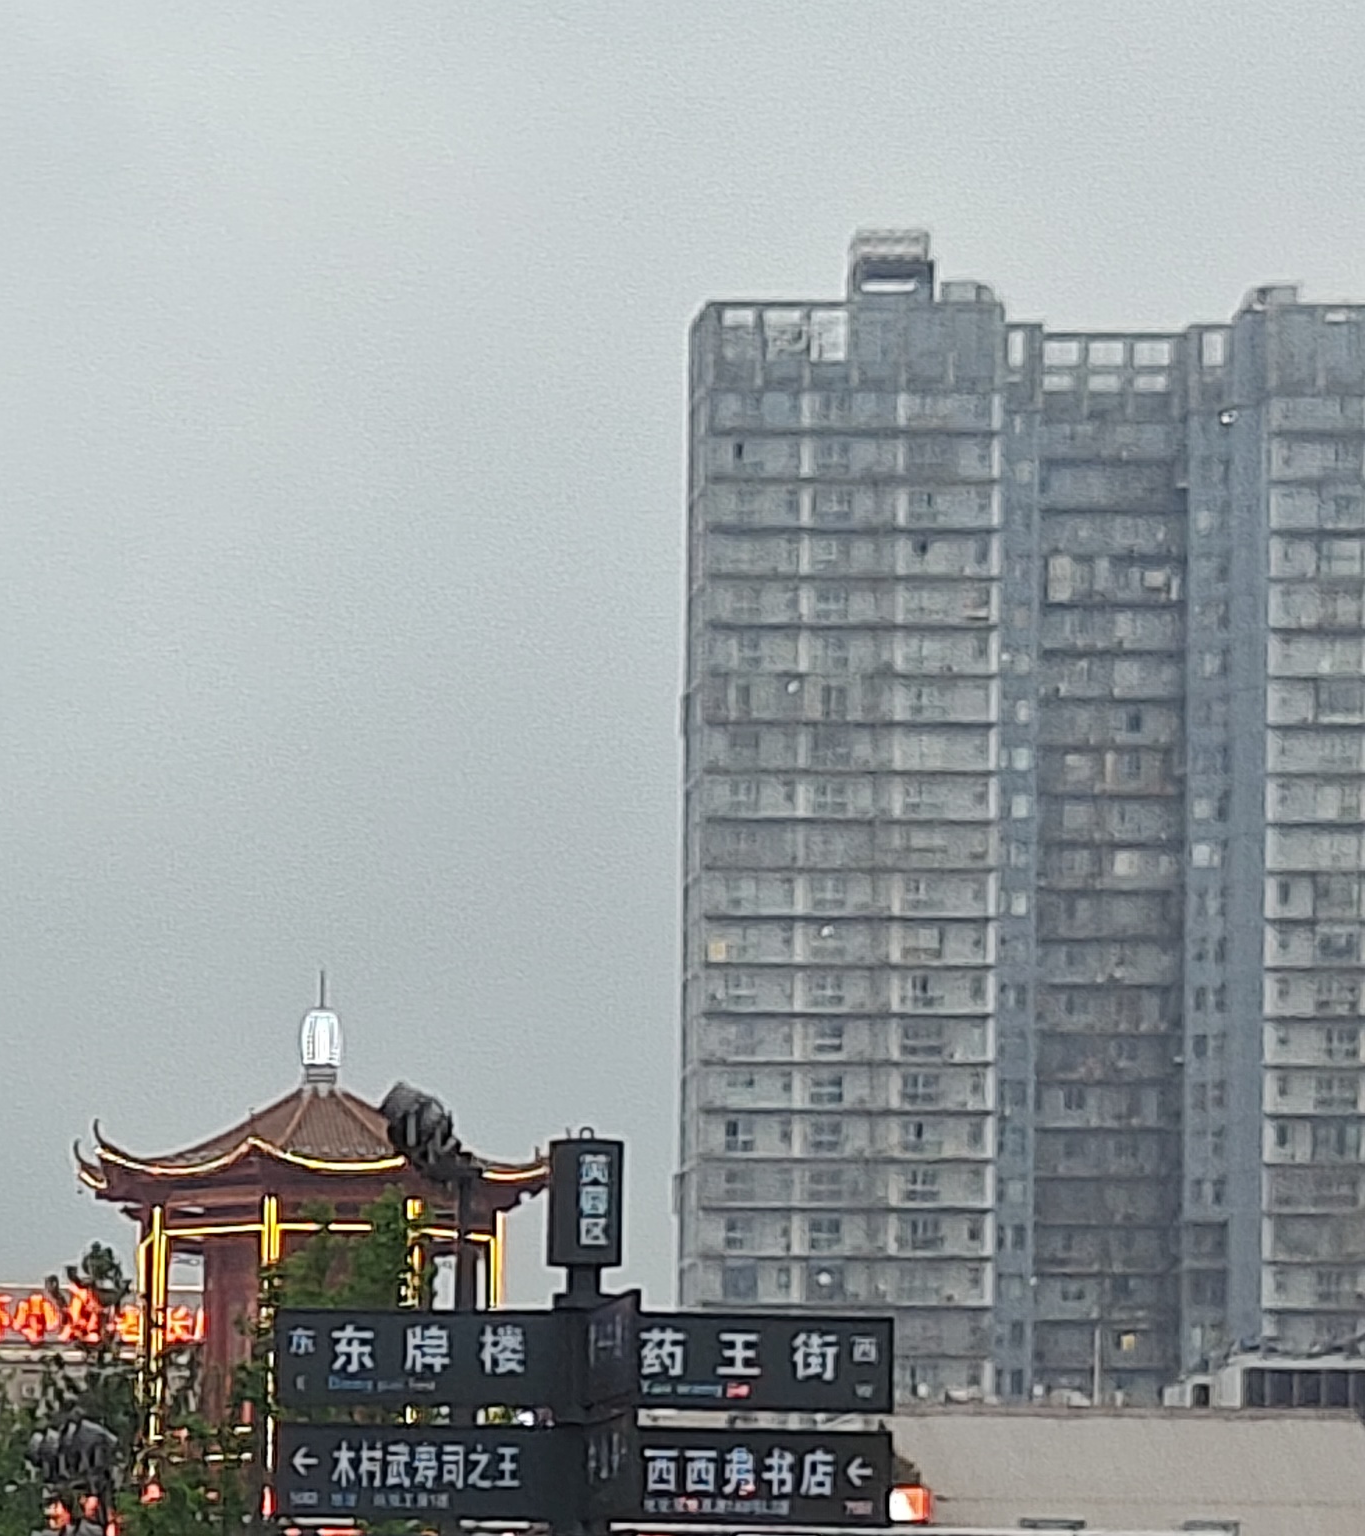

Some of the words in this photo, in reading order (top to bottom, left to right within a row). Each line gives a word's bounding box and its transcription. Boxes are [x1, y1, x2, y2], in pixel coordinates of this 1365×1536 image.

[288, 1326, 317, 1356] 东
[331, 1323, 527, 1375] 东牌楼
[638, 1326, 841, 1382] 药王街
[850, 1336, 879, 1363] 西
[643, 1446, 837, 1498] 西西弗书店
